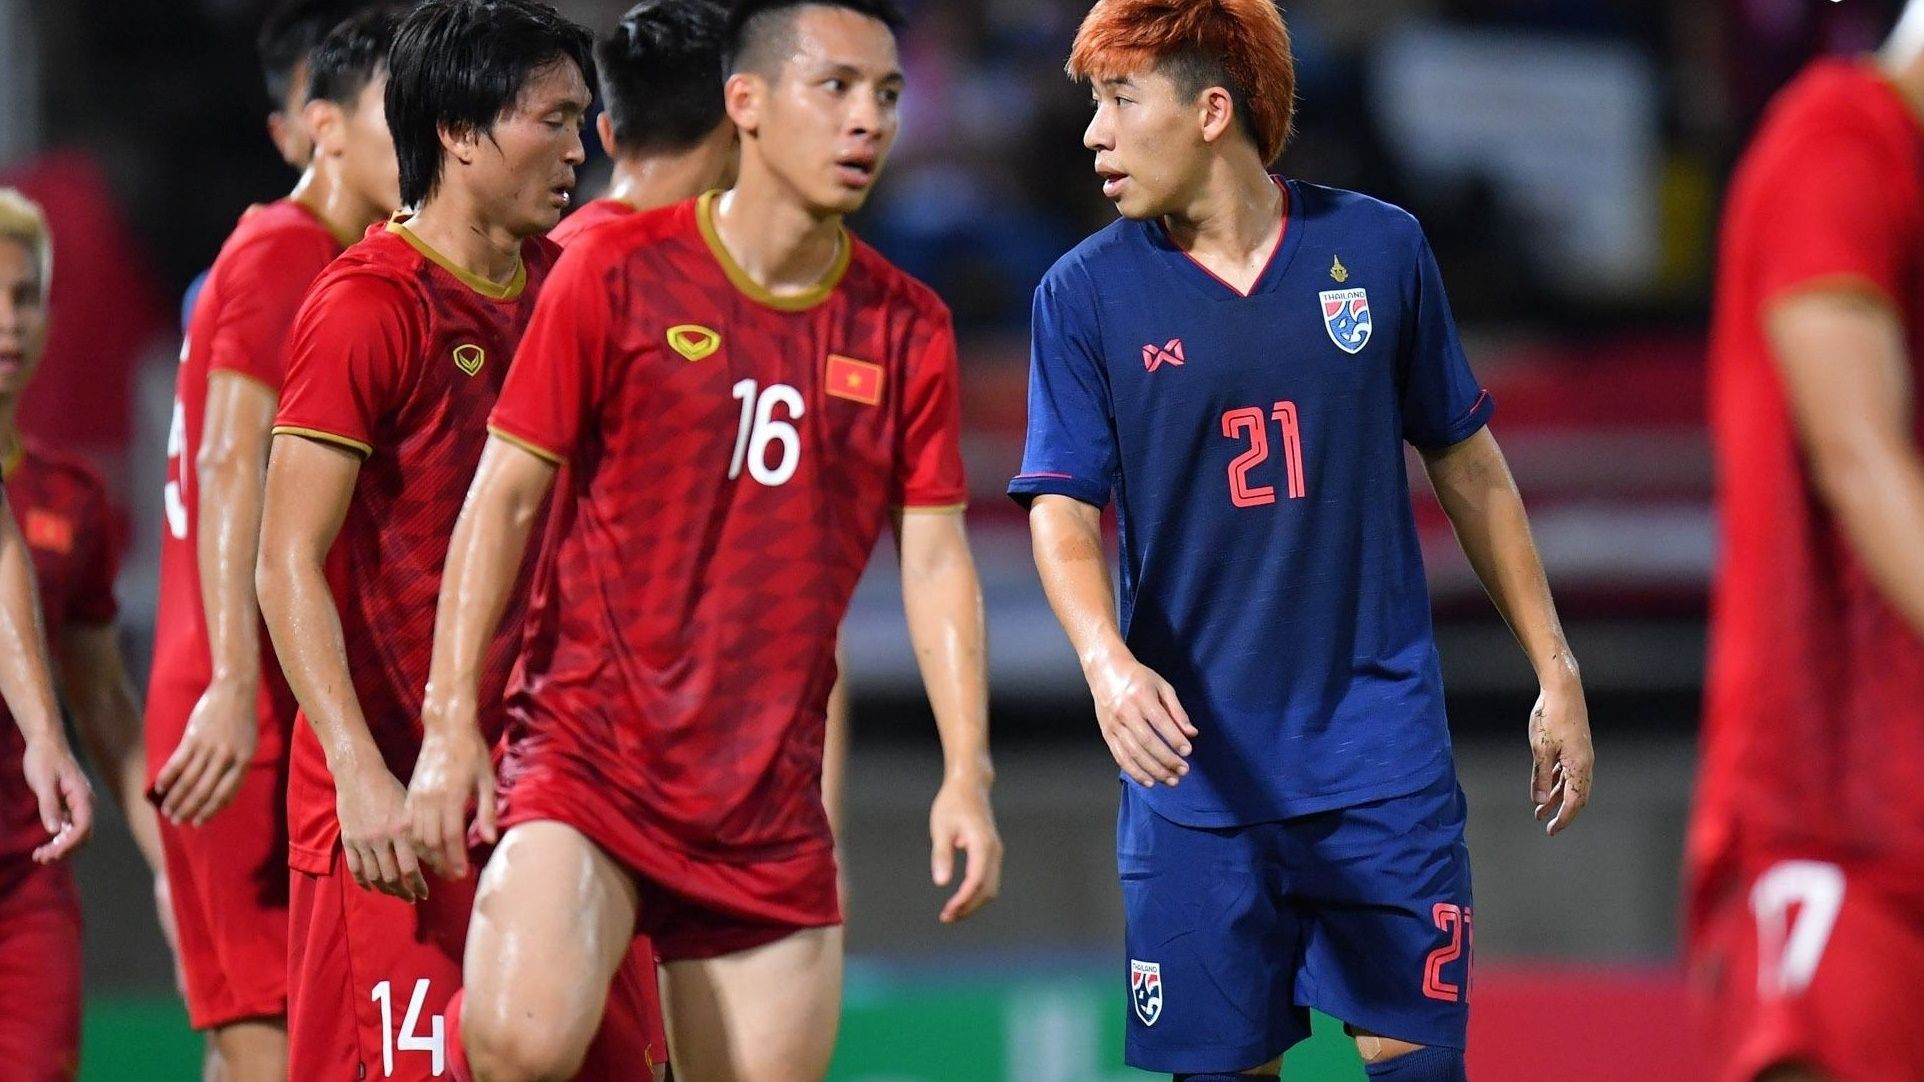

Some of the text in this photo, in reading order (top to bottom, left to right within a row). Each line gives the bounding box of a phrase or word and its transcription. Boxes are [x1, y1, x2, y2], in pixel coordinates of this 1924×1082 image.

[1323, 291, 1365, 301] THAILAND
[728, 378, 806, 487] 16
[1221, 400, 1306, 508] 21
[371, 978, 445, 1078] 14
